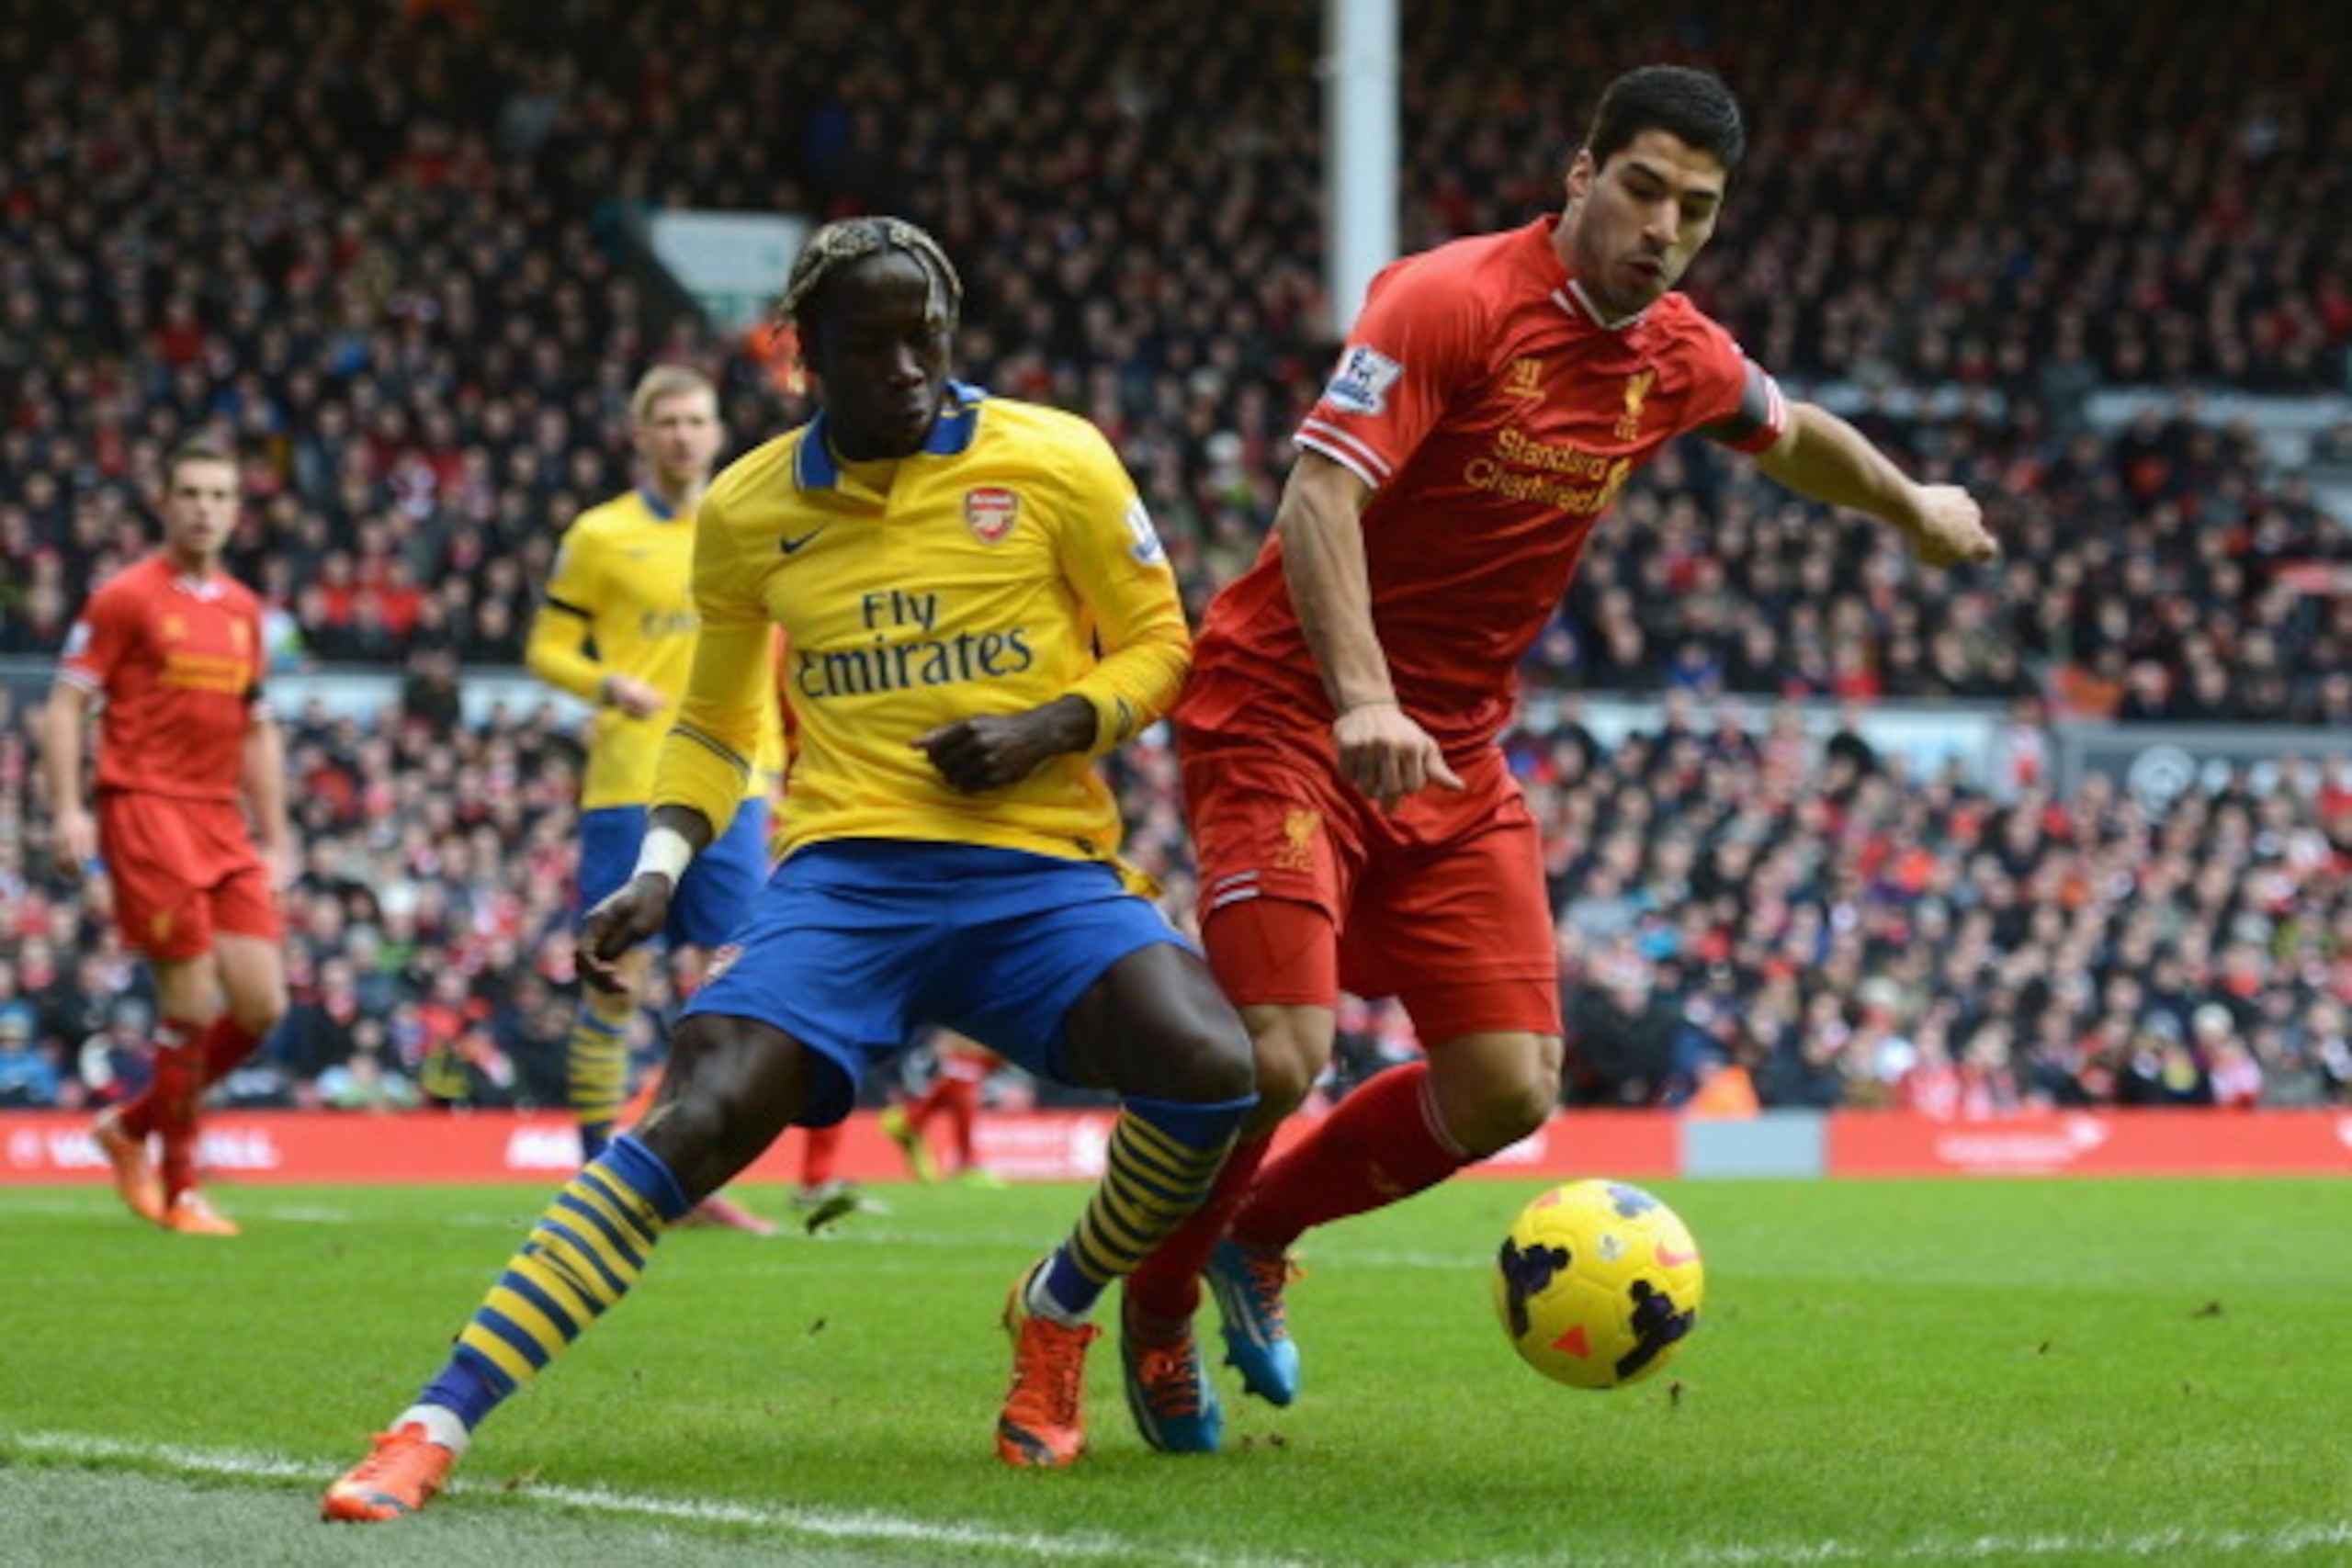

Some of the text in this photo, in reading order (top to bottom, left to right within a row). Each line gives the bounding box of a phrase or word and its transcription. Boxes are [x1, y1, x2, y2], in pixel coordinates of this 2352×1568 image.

[1494, 426, 1606, 481] Standard
[1464, 458, 1603, 516] Chartered
[862, 590, 935, 630] Fly
[797, 627, 1032, 698] Emirates
